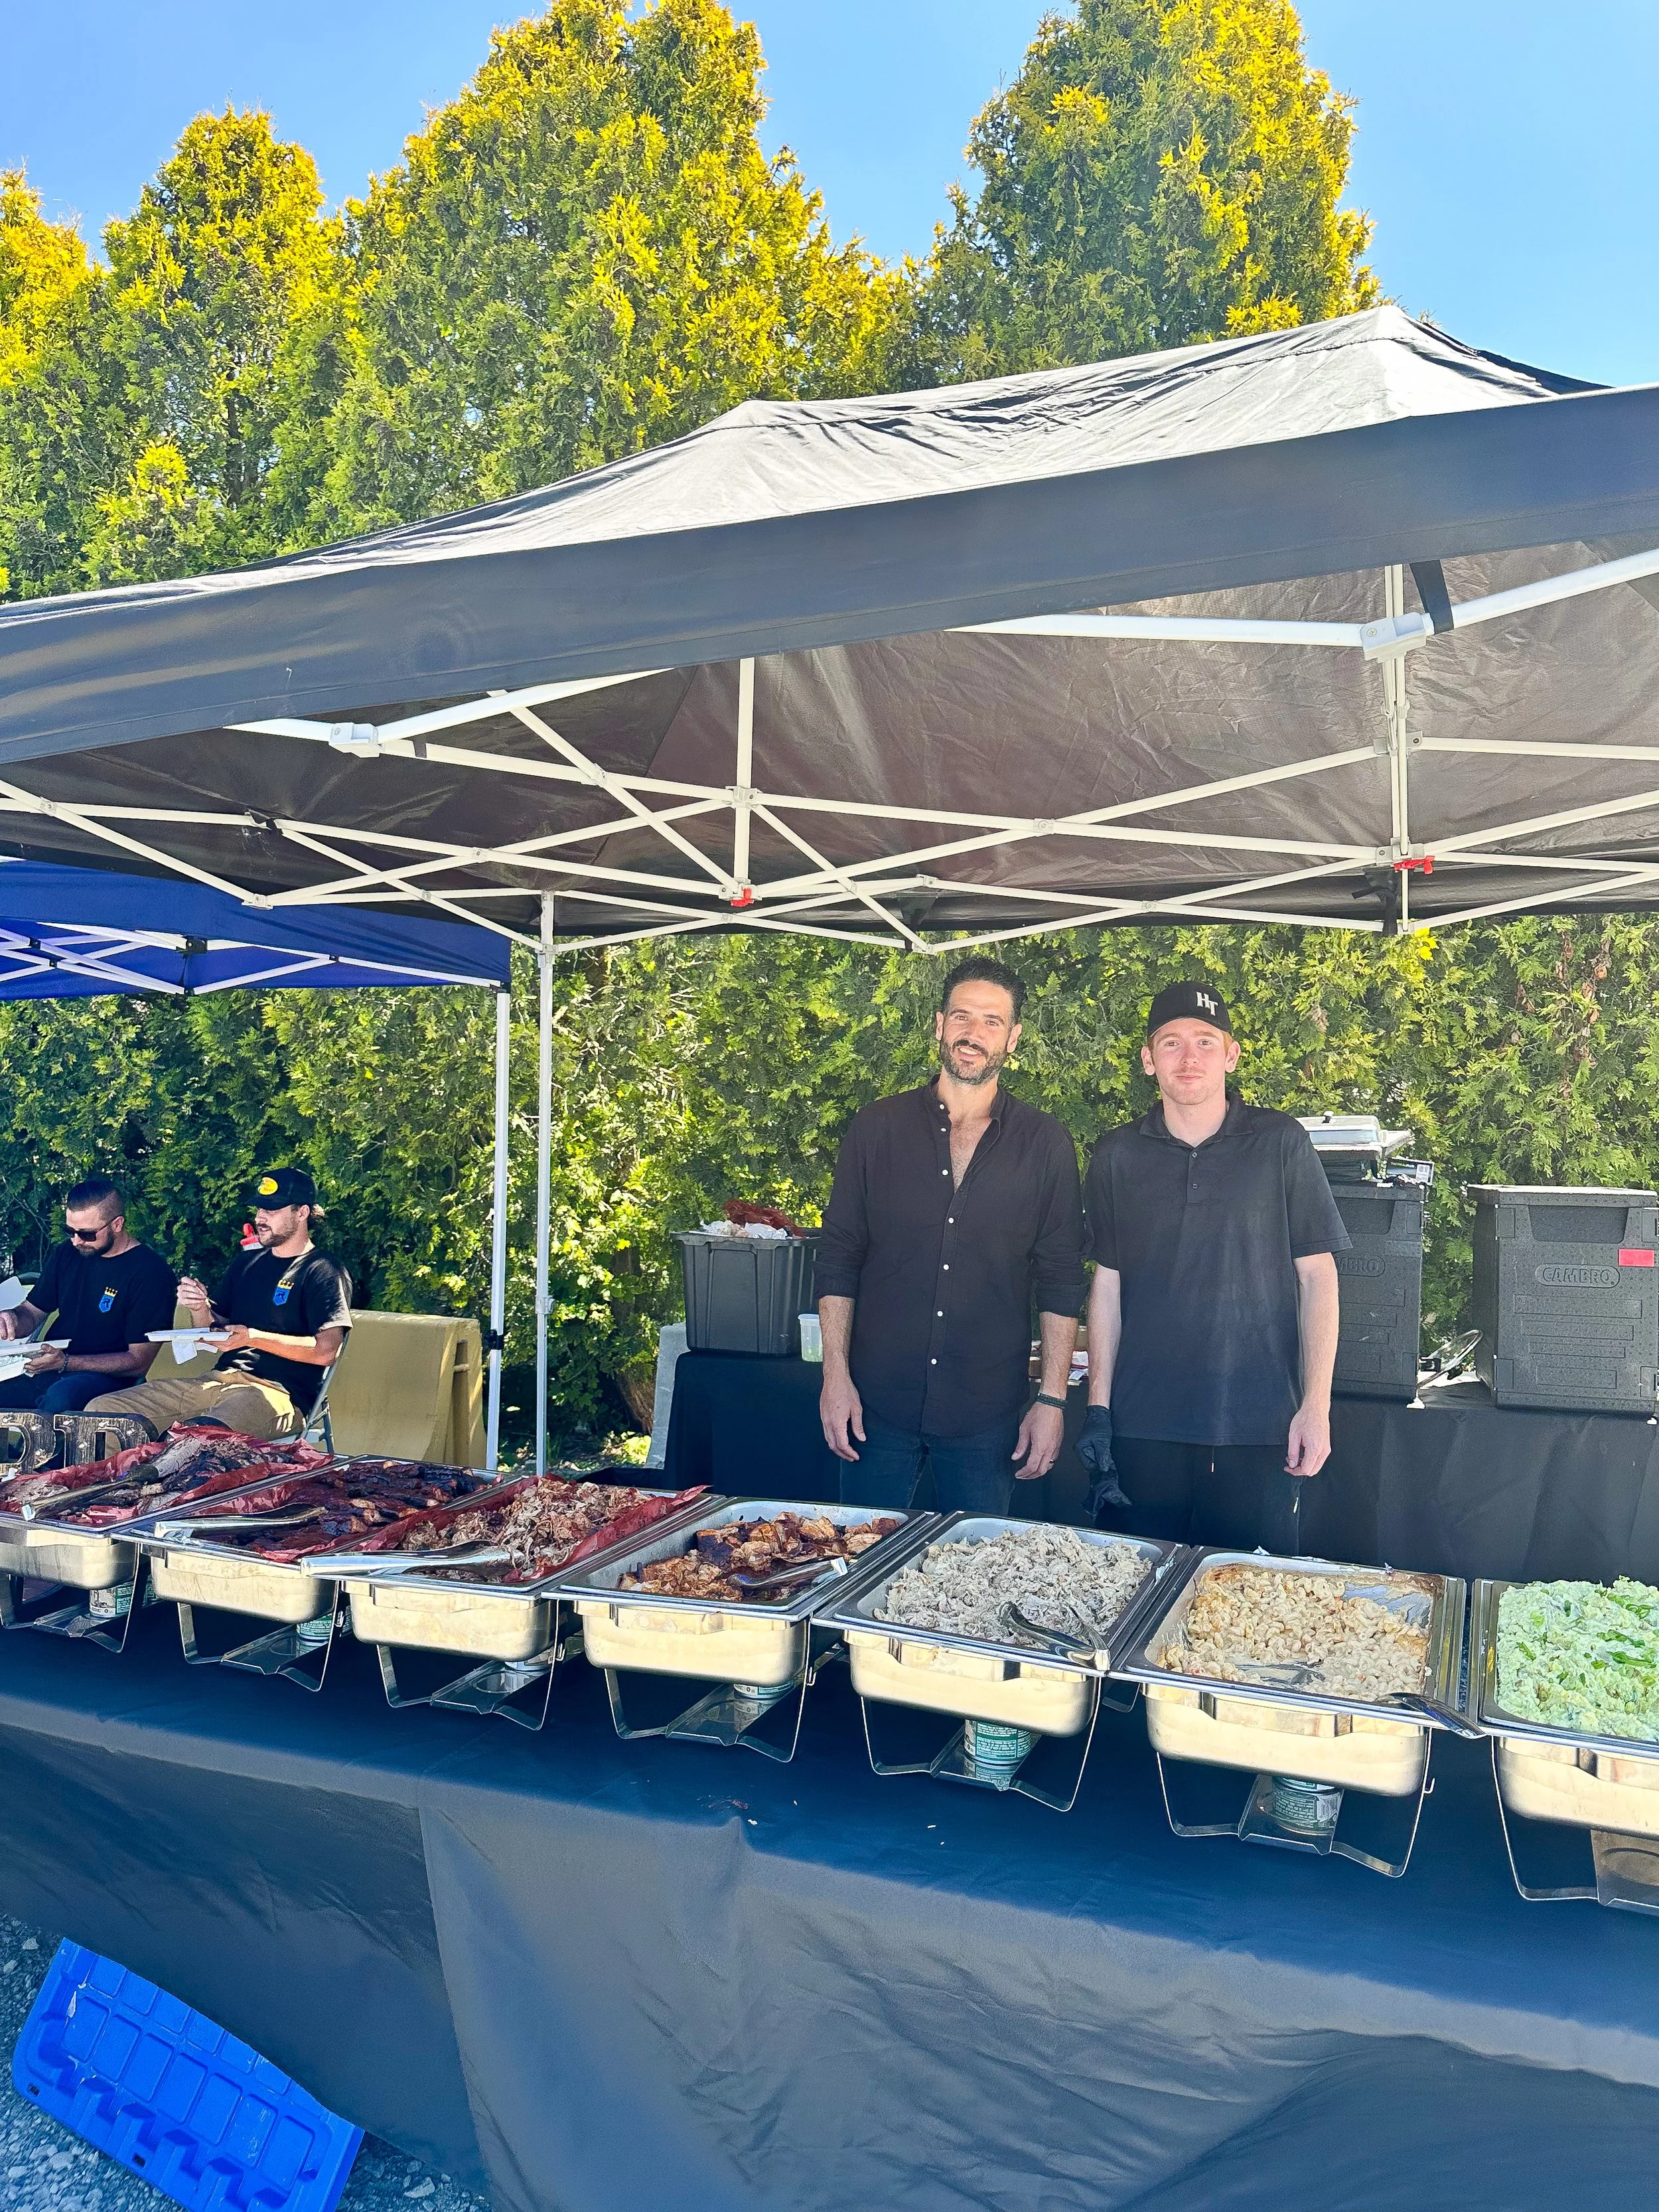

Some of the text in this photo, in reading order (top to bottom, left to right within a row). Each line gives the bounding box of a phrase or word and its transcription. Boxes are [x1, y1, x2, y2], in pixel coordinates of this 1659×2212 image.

[1196, 991, 1218, 1016] HT
[1335, 1256, 1380, 1272] MBRO
[1542, 1266, 1612, 1284] CAMBRO
